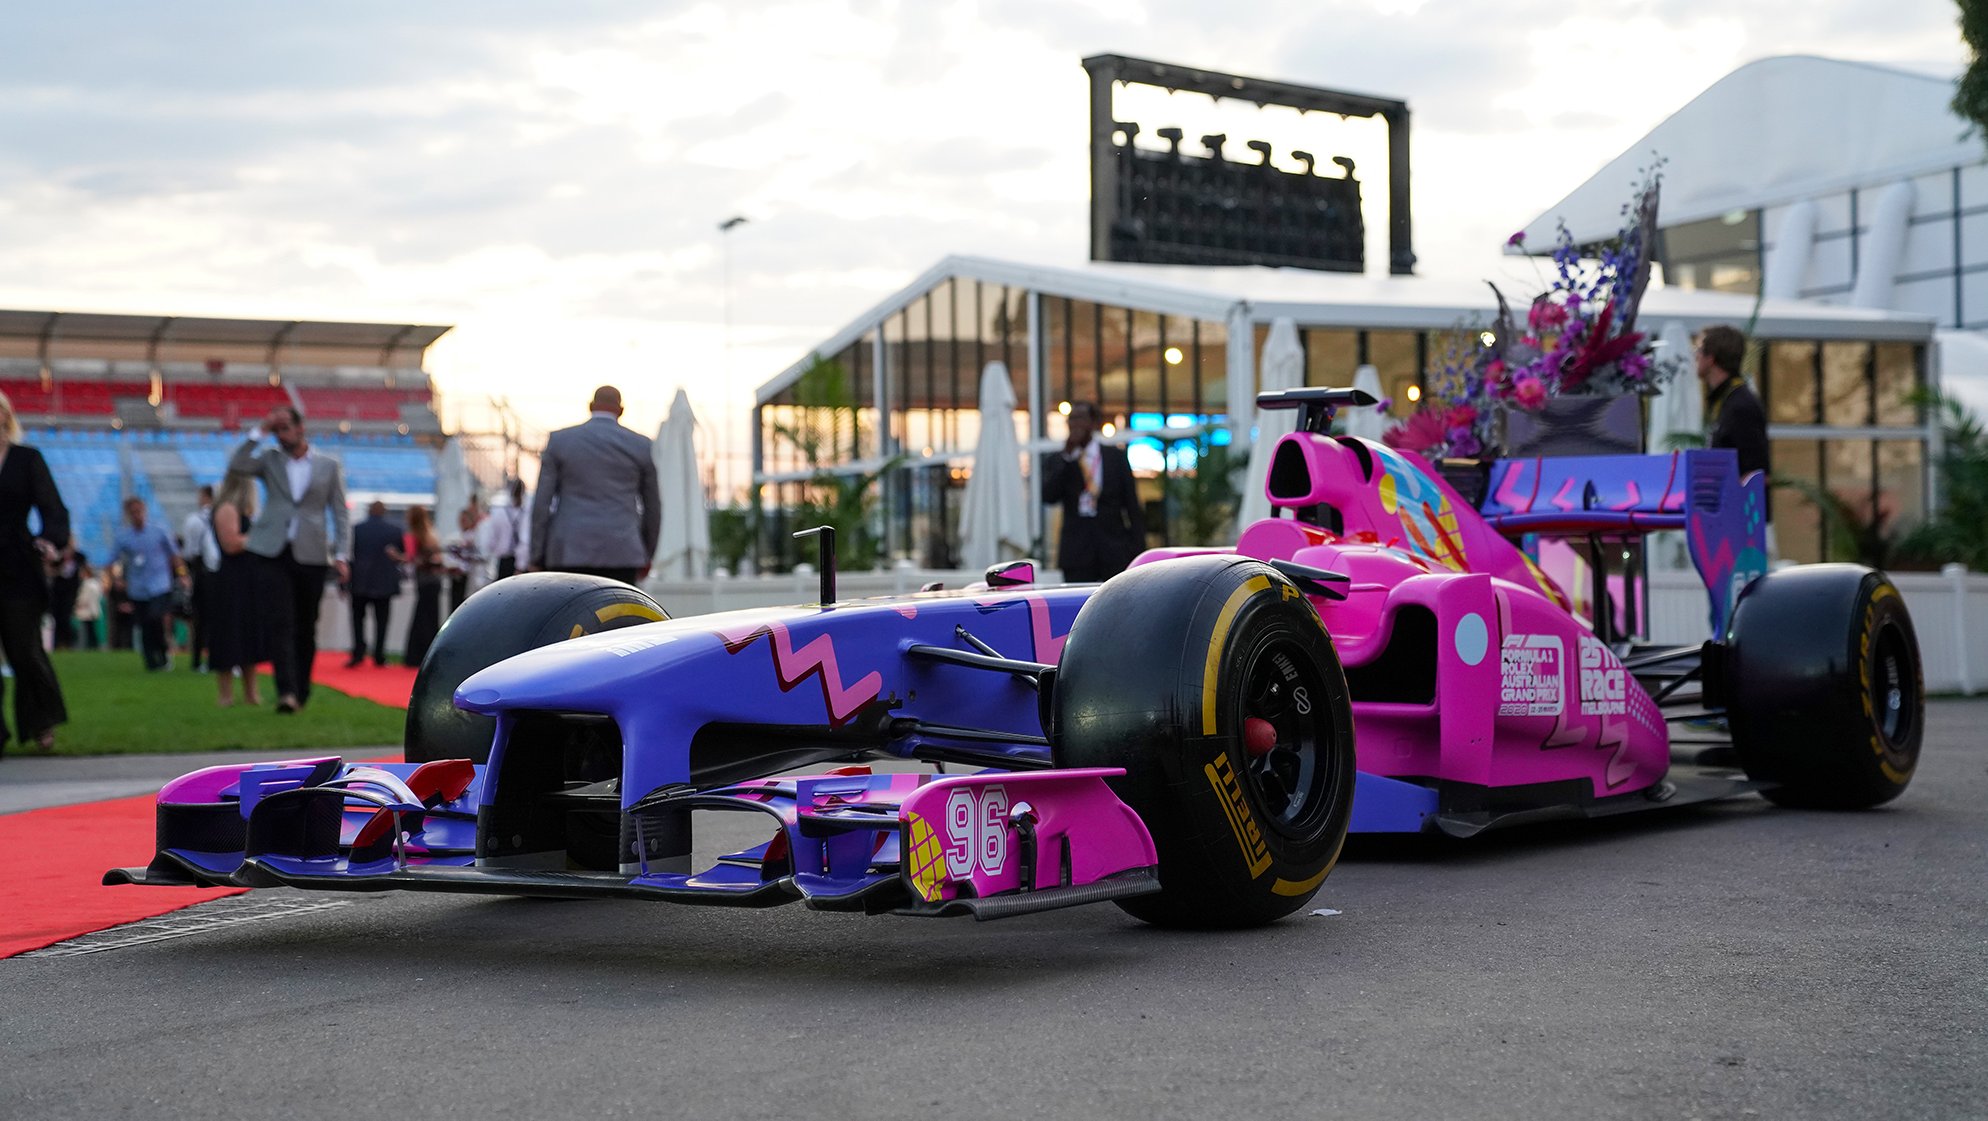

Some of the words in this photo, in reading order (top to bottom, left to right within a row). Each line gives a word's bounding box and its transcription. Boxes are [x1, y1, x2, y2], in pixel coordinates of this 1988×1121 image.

[1501, 649, 1547, 663] FORMULA
[1548, 649, 1554, 663] 1
[1272, 652, 1299, 682] ENKEI
[1501, 662, 1533, 676] ROLEX
[1501, 675, 1559, 689] AUSTRALIAN
[1501, 688, 1536, 702] GRAND
[1536, 688, 1557, 702] PRIX
[1499, 704, 1529, 715] 2020
[1204, 751, 1273, 880] PIRELLI
[946, 784, 1008, 881] 96
